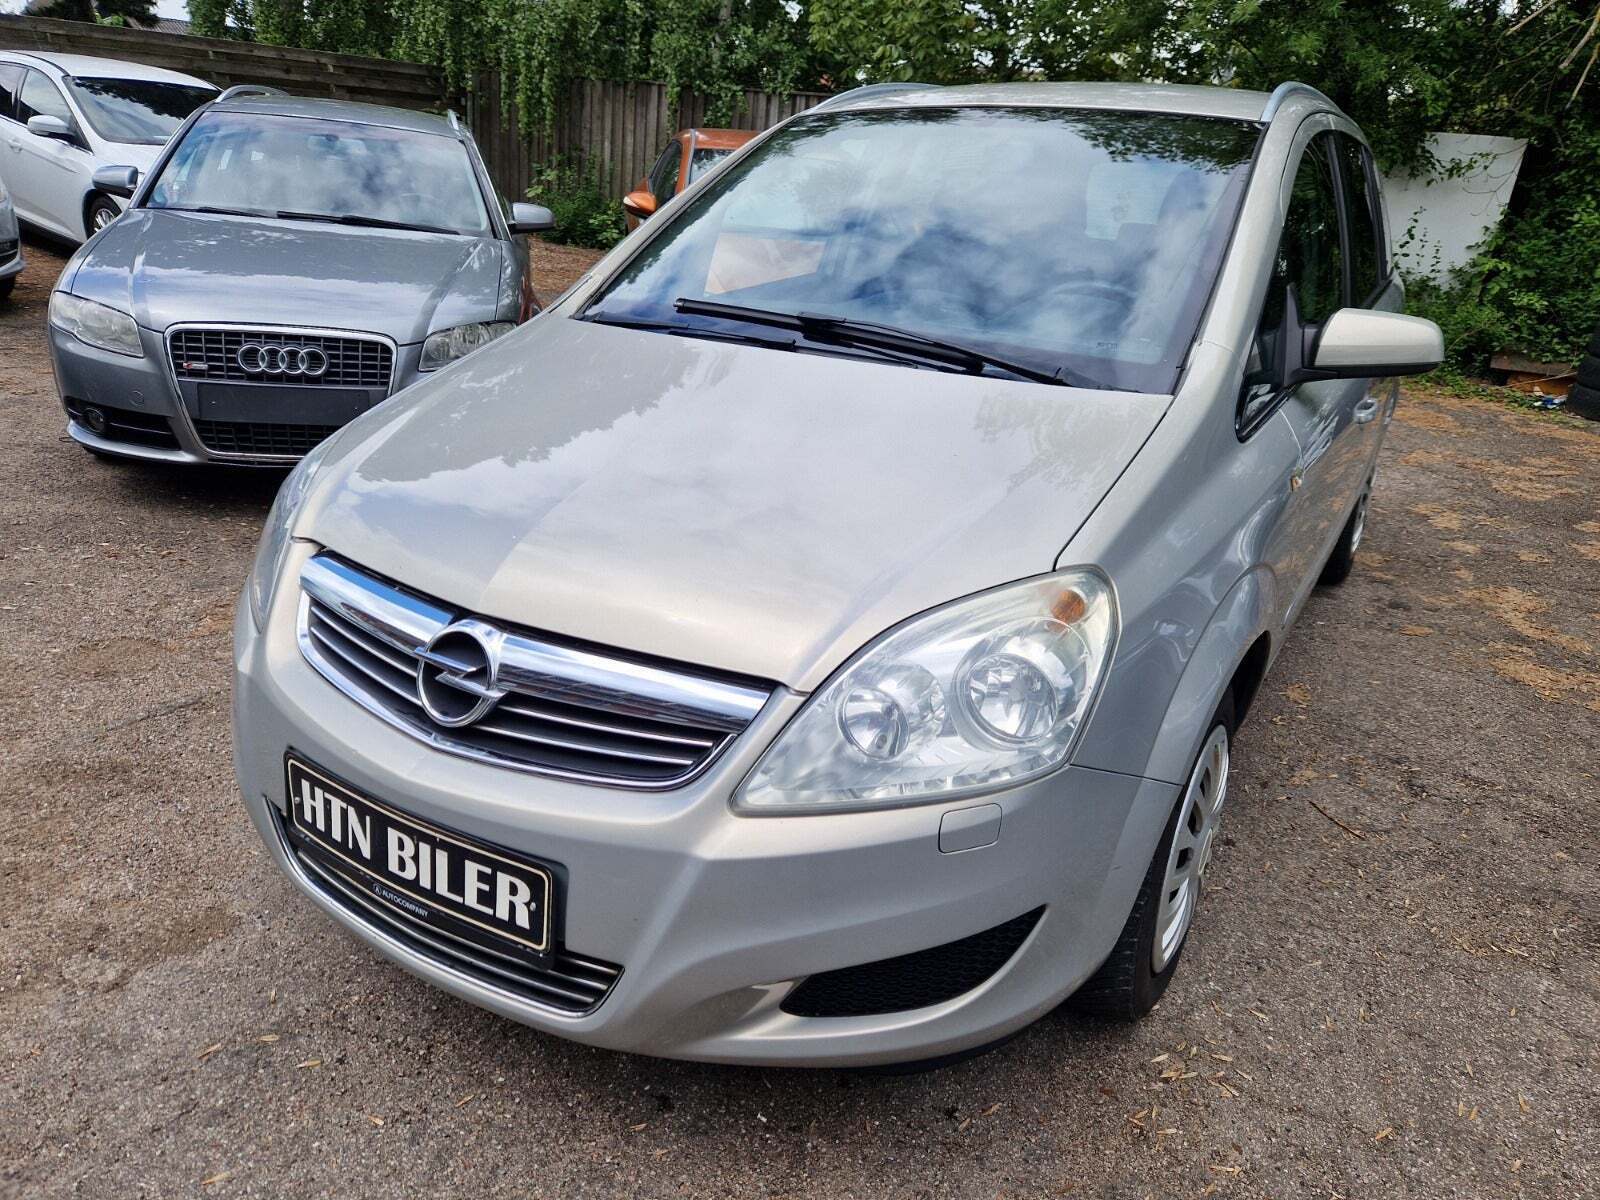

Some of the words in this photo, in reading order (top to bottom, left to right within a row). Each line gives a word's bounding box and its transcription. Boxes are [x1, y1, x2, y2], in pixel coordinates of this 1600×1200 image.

[301, 778, 371, 860] HTN
[387, 826, 531, 930] BILER
[382, 890, 428, 917] AUTOCOMPANY
